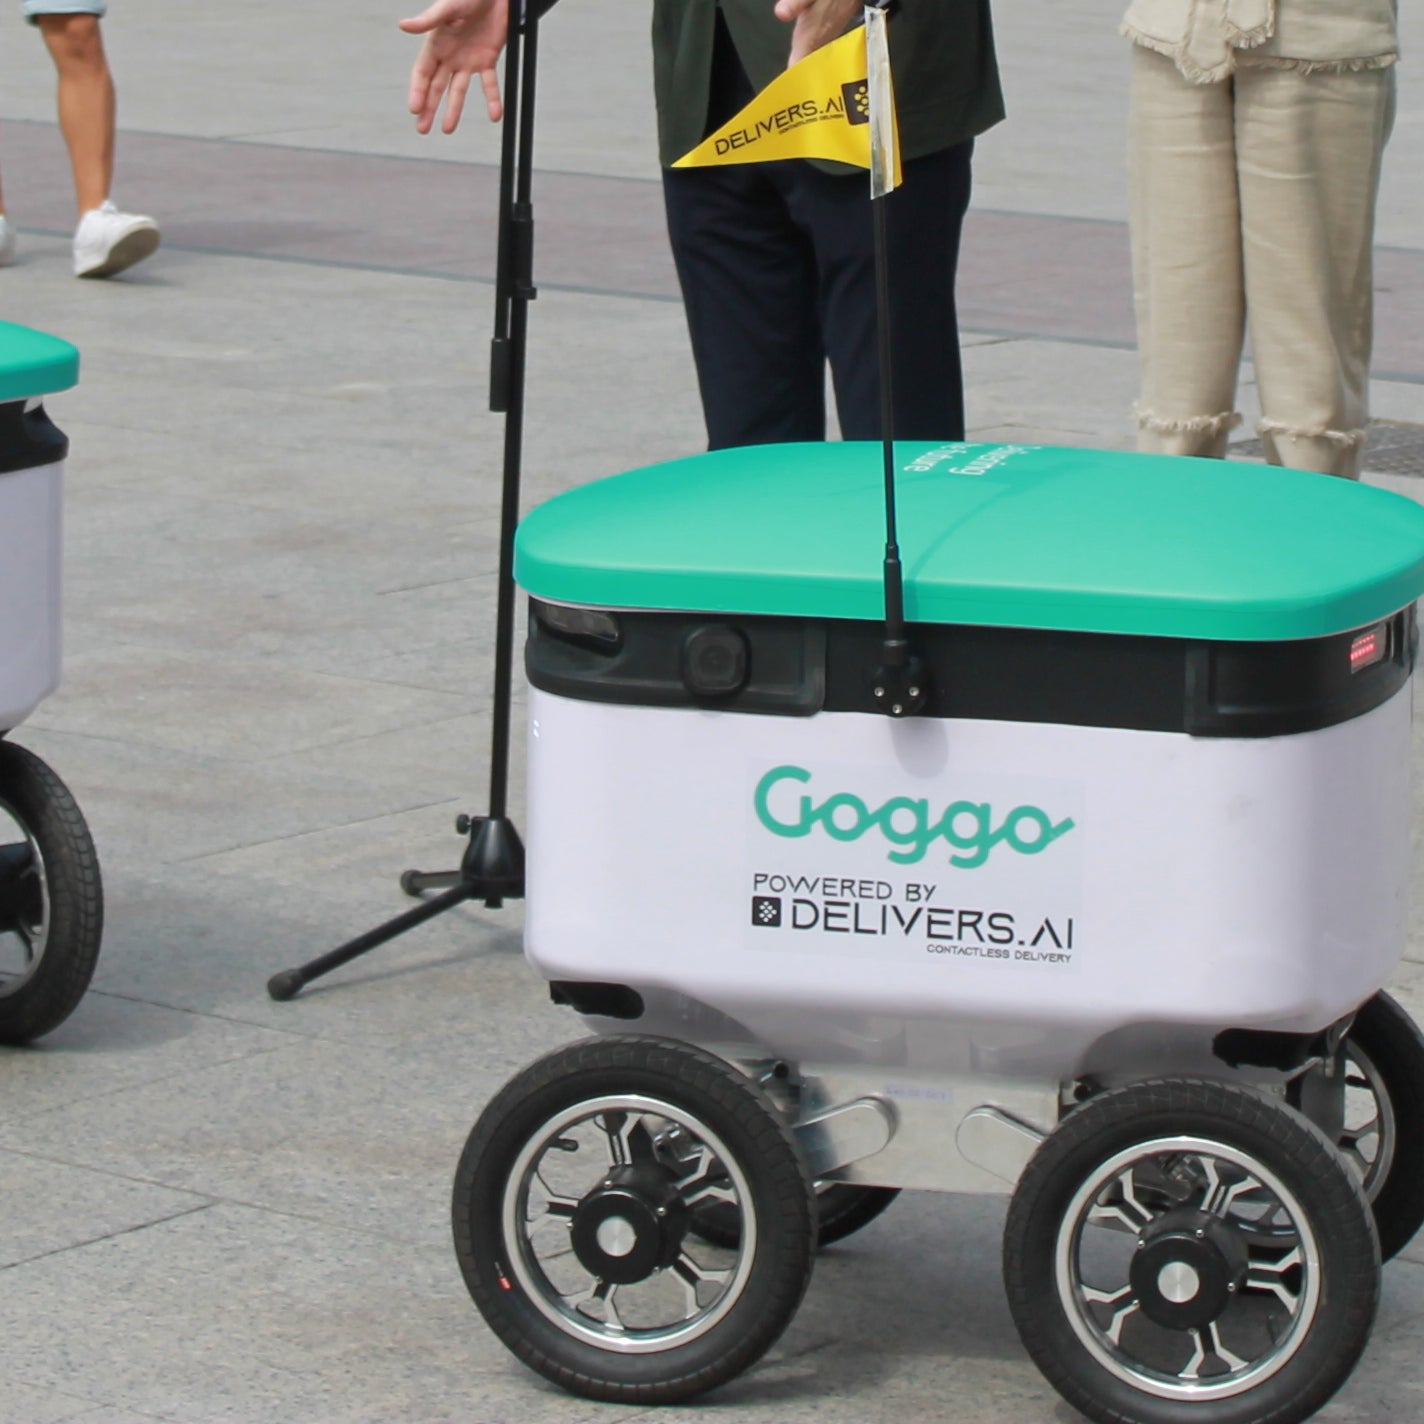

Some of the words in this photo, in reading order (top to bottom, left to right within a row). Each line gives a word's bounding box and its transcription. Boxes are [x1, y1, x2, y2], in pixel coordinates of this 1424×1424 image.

[714, 96, 844, 156] DELIVERS.AI
[754, 765, 1076, 869] Goggo
[753, 872, 893, 900] POWERED
[905, 883, 936, 903] BY
[791, 898, 1074, 950] DELIVERS.AI
[926, 943, 1010, 960] CONTACTLESS
[1014, 950, 1072, 964] DELIVERY
